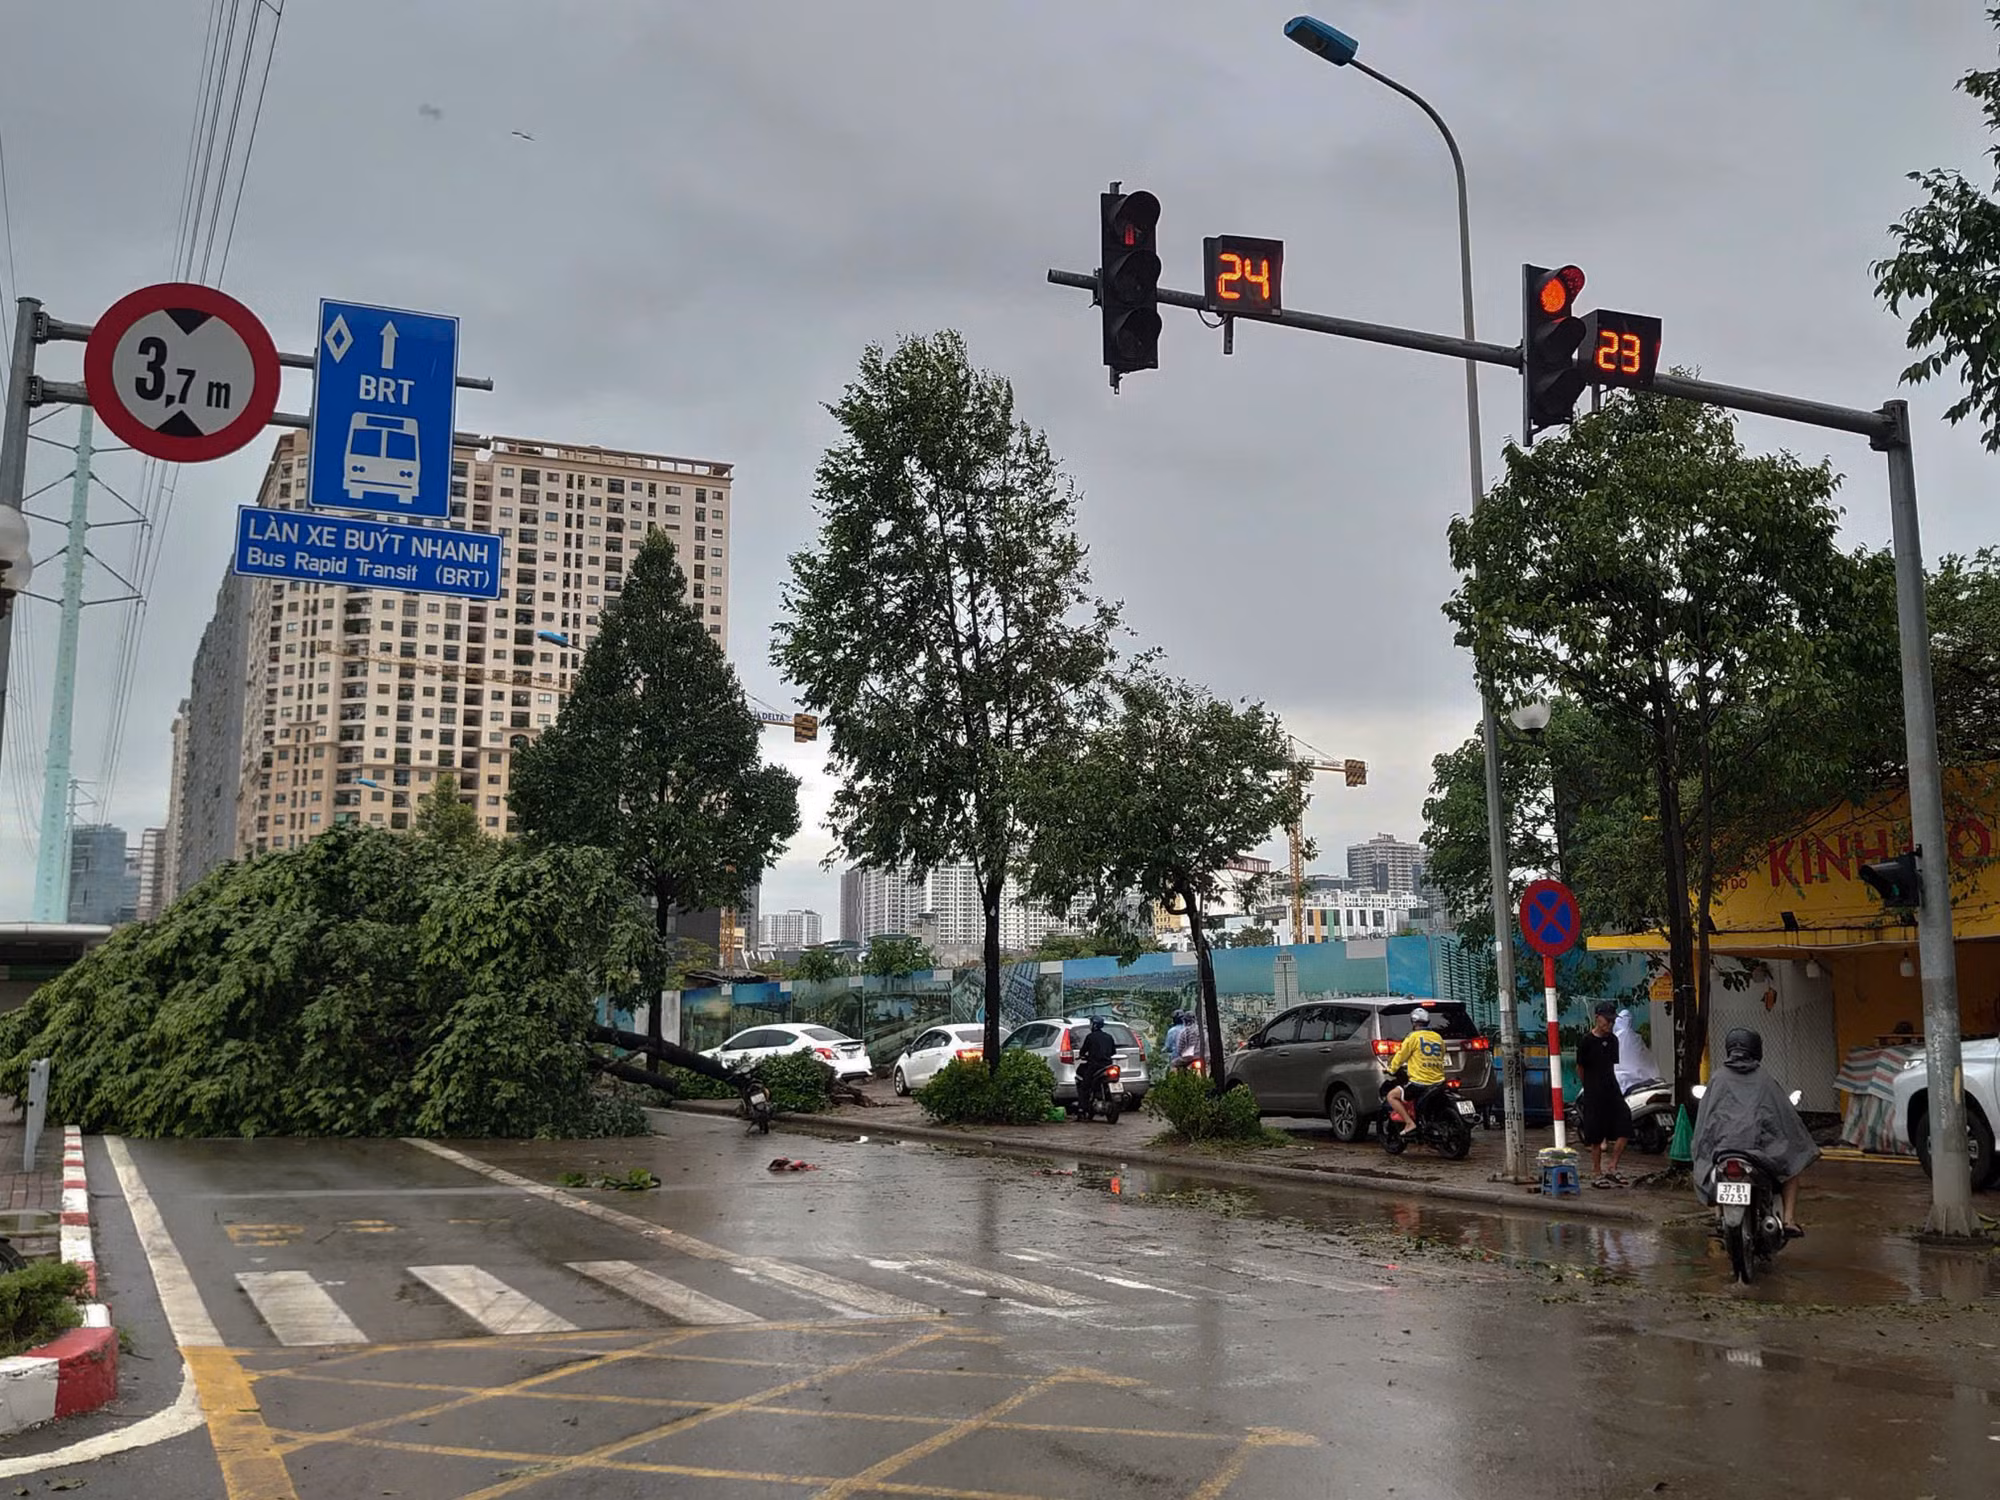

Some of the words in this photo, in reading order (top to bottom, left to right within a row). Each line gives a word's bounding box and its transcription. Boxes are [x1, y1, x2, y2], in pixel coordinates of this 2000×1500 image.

[1217, 252, 1270, 301] 24
[134, 336, 196, 408] 3,7
[207, 380, 231, 410] m
[1597, 330, 1642, 374] 23
[359, 374, 415, 406] BRT
[248, 516, 299, 544] LÀN
[307, 525, 337, 548] XE
[344, 525, 404, 554] BUÝT
[411, 539, 489, 565] NHANH
[247, 549, 286, 569] Bus
[294, 552, 348, 576] Rapid
[358, 558, 418, 582] Transit
[435, 566, 490, 589] (BRT)
[1420, 1036, 1441, 1056] be
